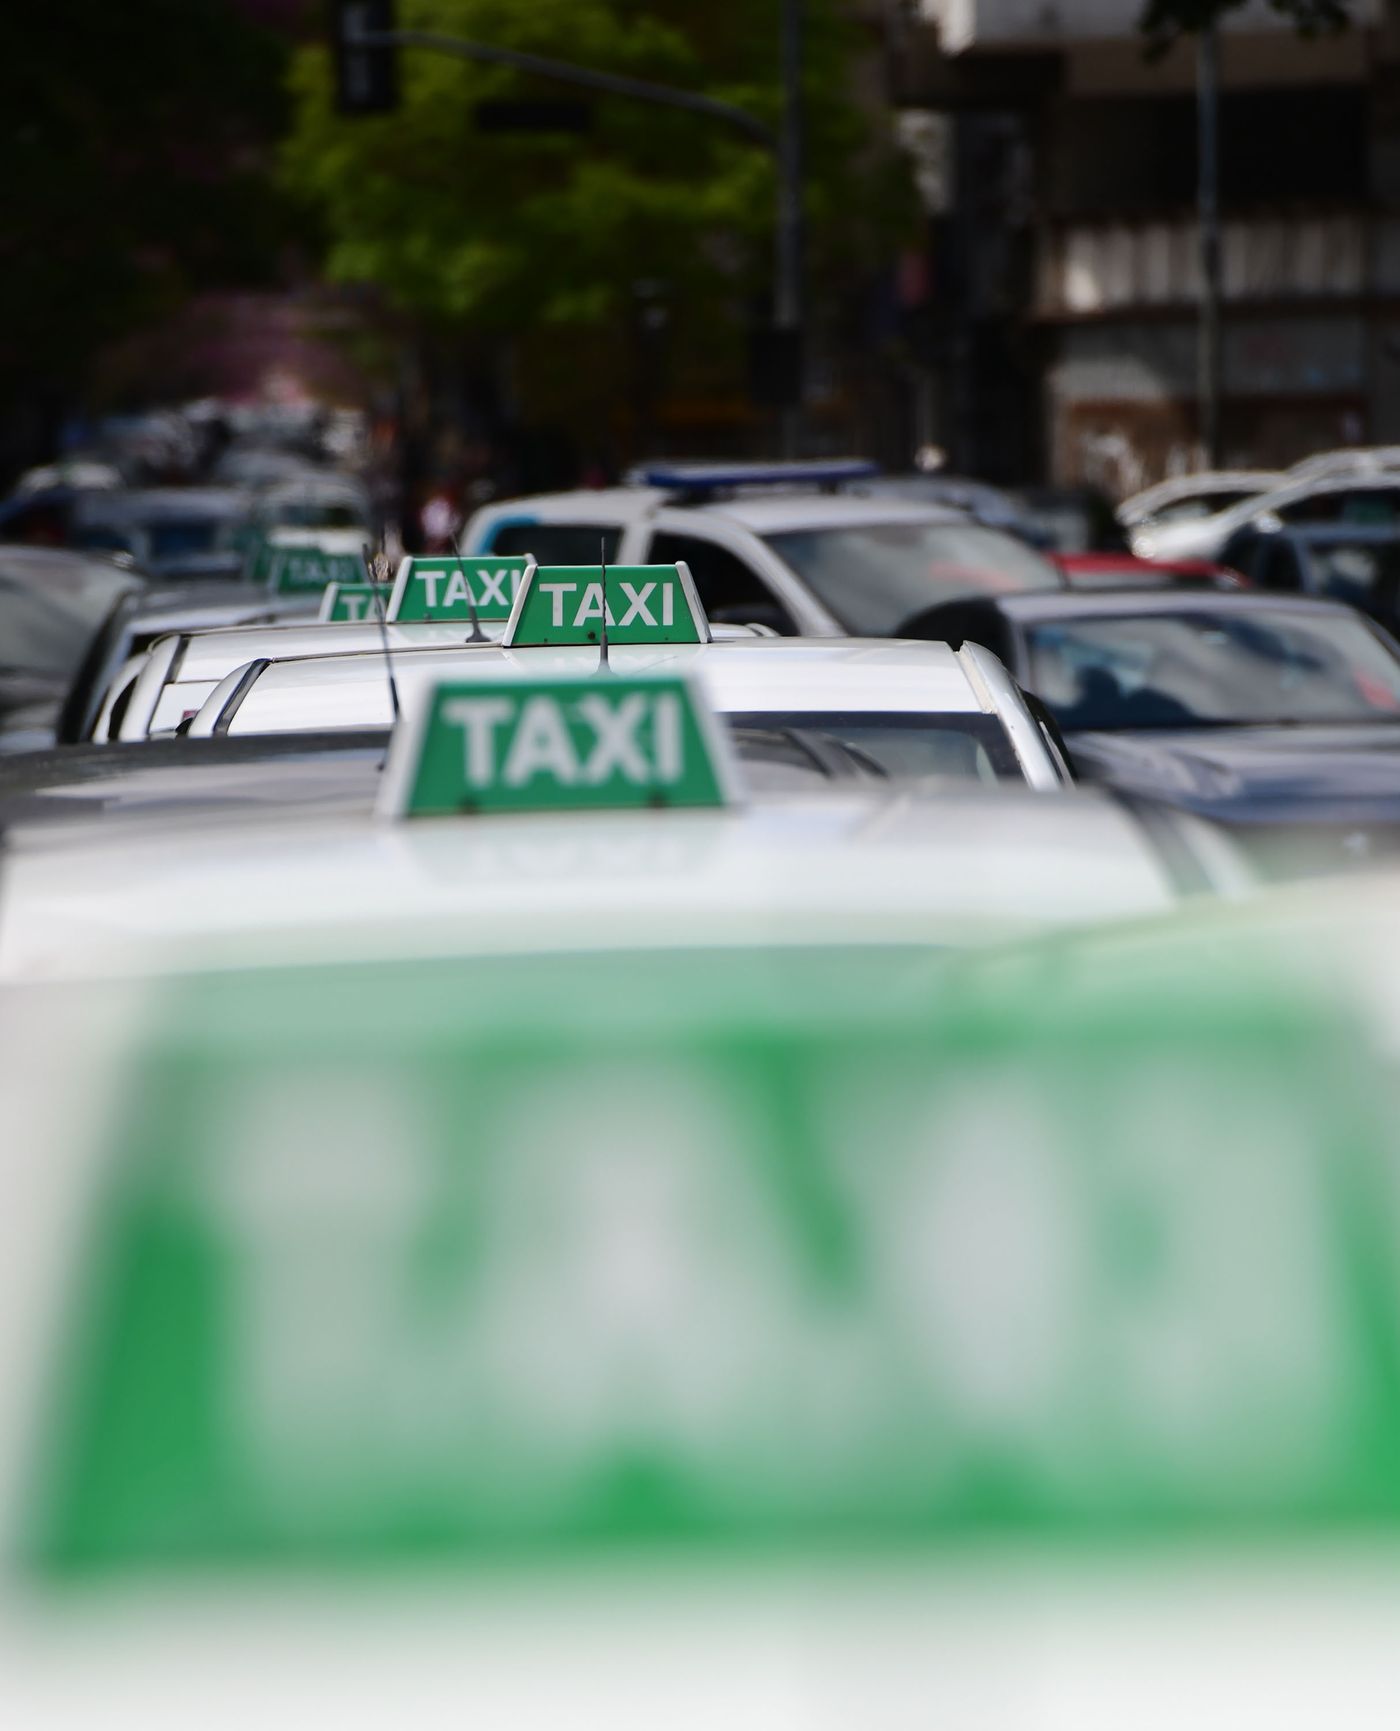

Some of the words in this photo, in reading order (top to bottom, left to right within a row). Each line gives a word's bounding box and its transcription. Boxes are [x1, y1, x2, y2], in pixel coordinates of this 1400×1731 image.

[415, 569, 521, 607] TAXI
[539, 582, 673, 627] TAXI
[439, 692, 684, 788] TAXI
